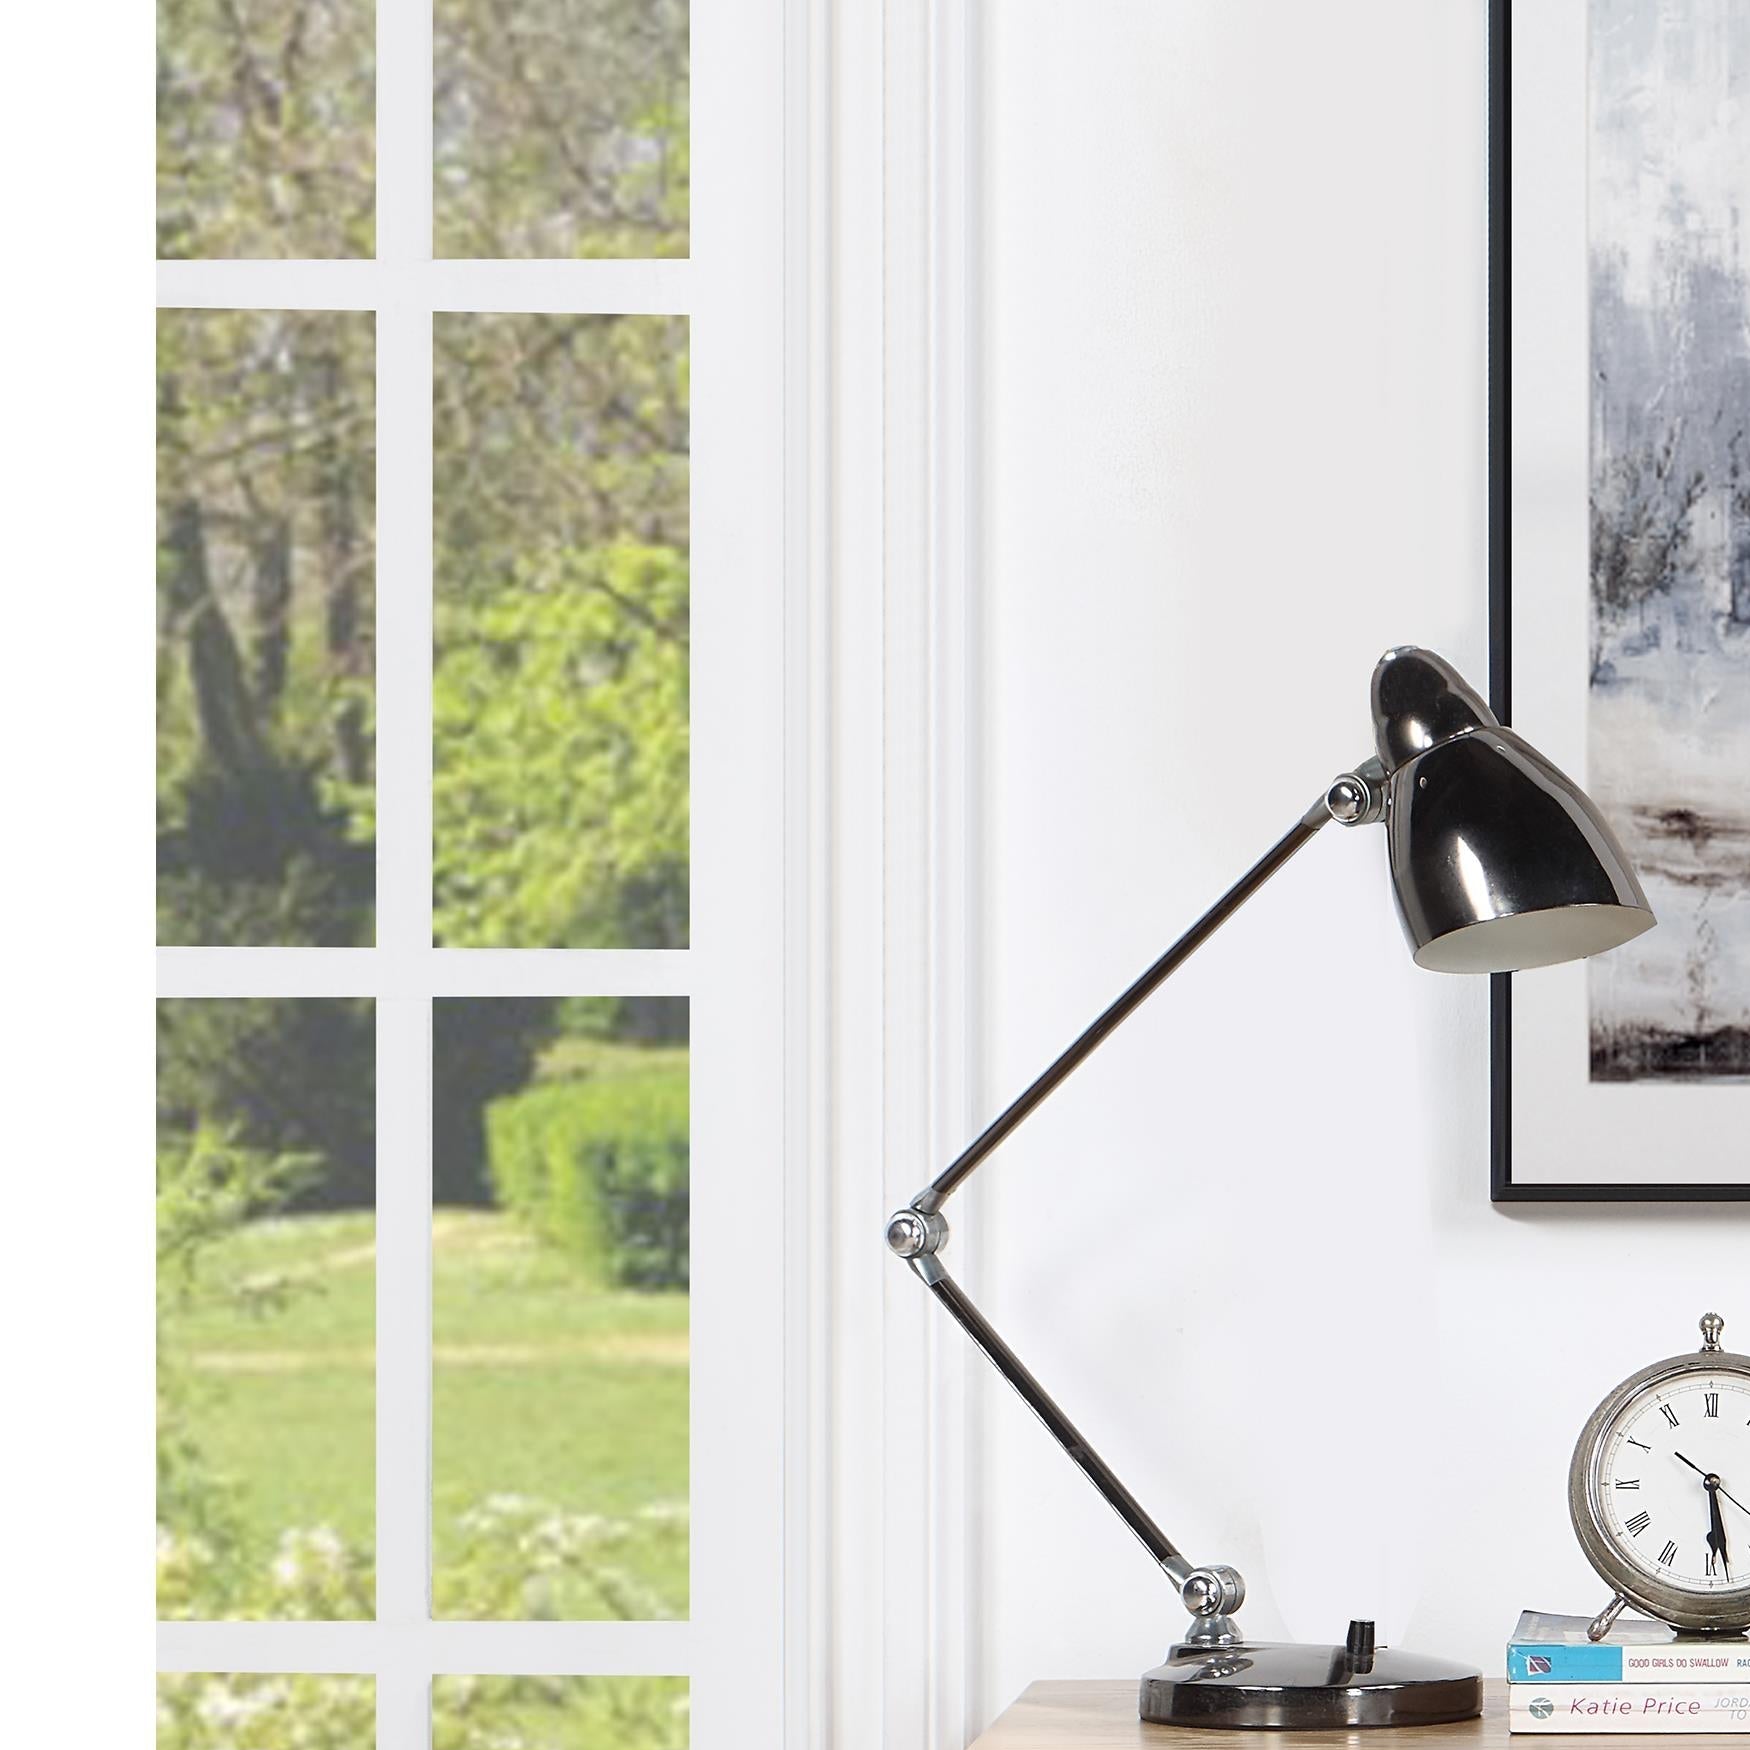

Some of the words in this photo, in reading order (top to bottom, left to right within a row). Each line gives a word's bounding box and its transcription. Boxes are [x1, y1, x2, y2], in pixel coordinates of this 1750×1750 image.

[1704, 1393, 1718, 1418] XII
[1659, 1403, 1680, 1429] XI
[1627, 1435, 1651, 1454] X
[1615, 1479, 1640, 1490] IX
[1628, 1658, 1650, 1668] GOOD
[1652, 1658, 1674, 1668] GIRLS
[1676, 1658, 1687, 1668] DO
[1689, 1658, 1729, 1668] SWALLOW
[1570, 1697, 1632, 1715] Katie
[1643, 1697, 1701, 1715] Price
[1729, 1709, 1747, 1720] TO
